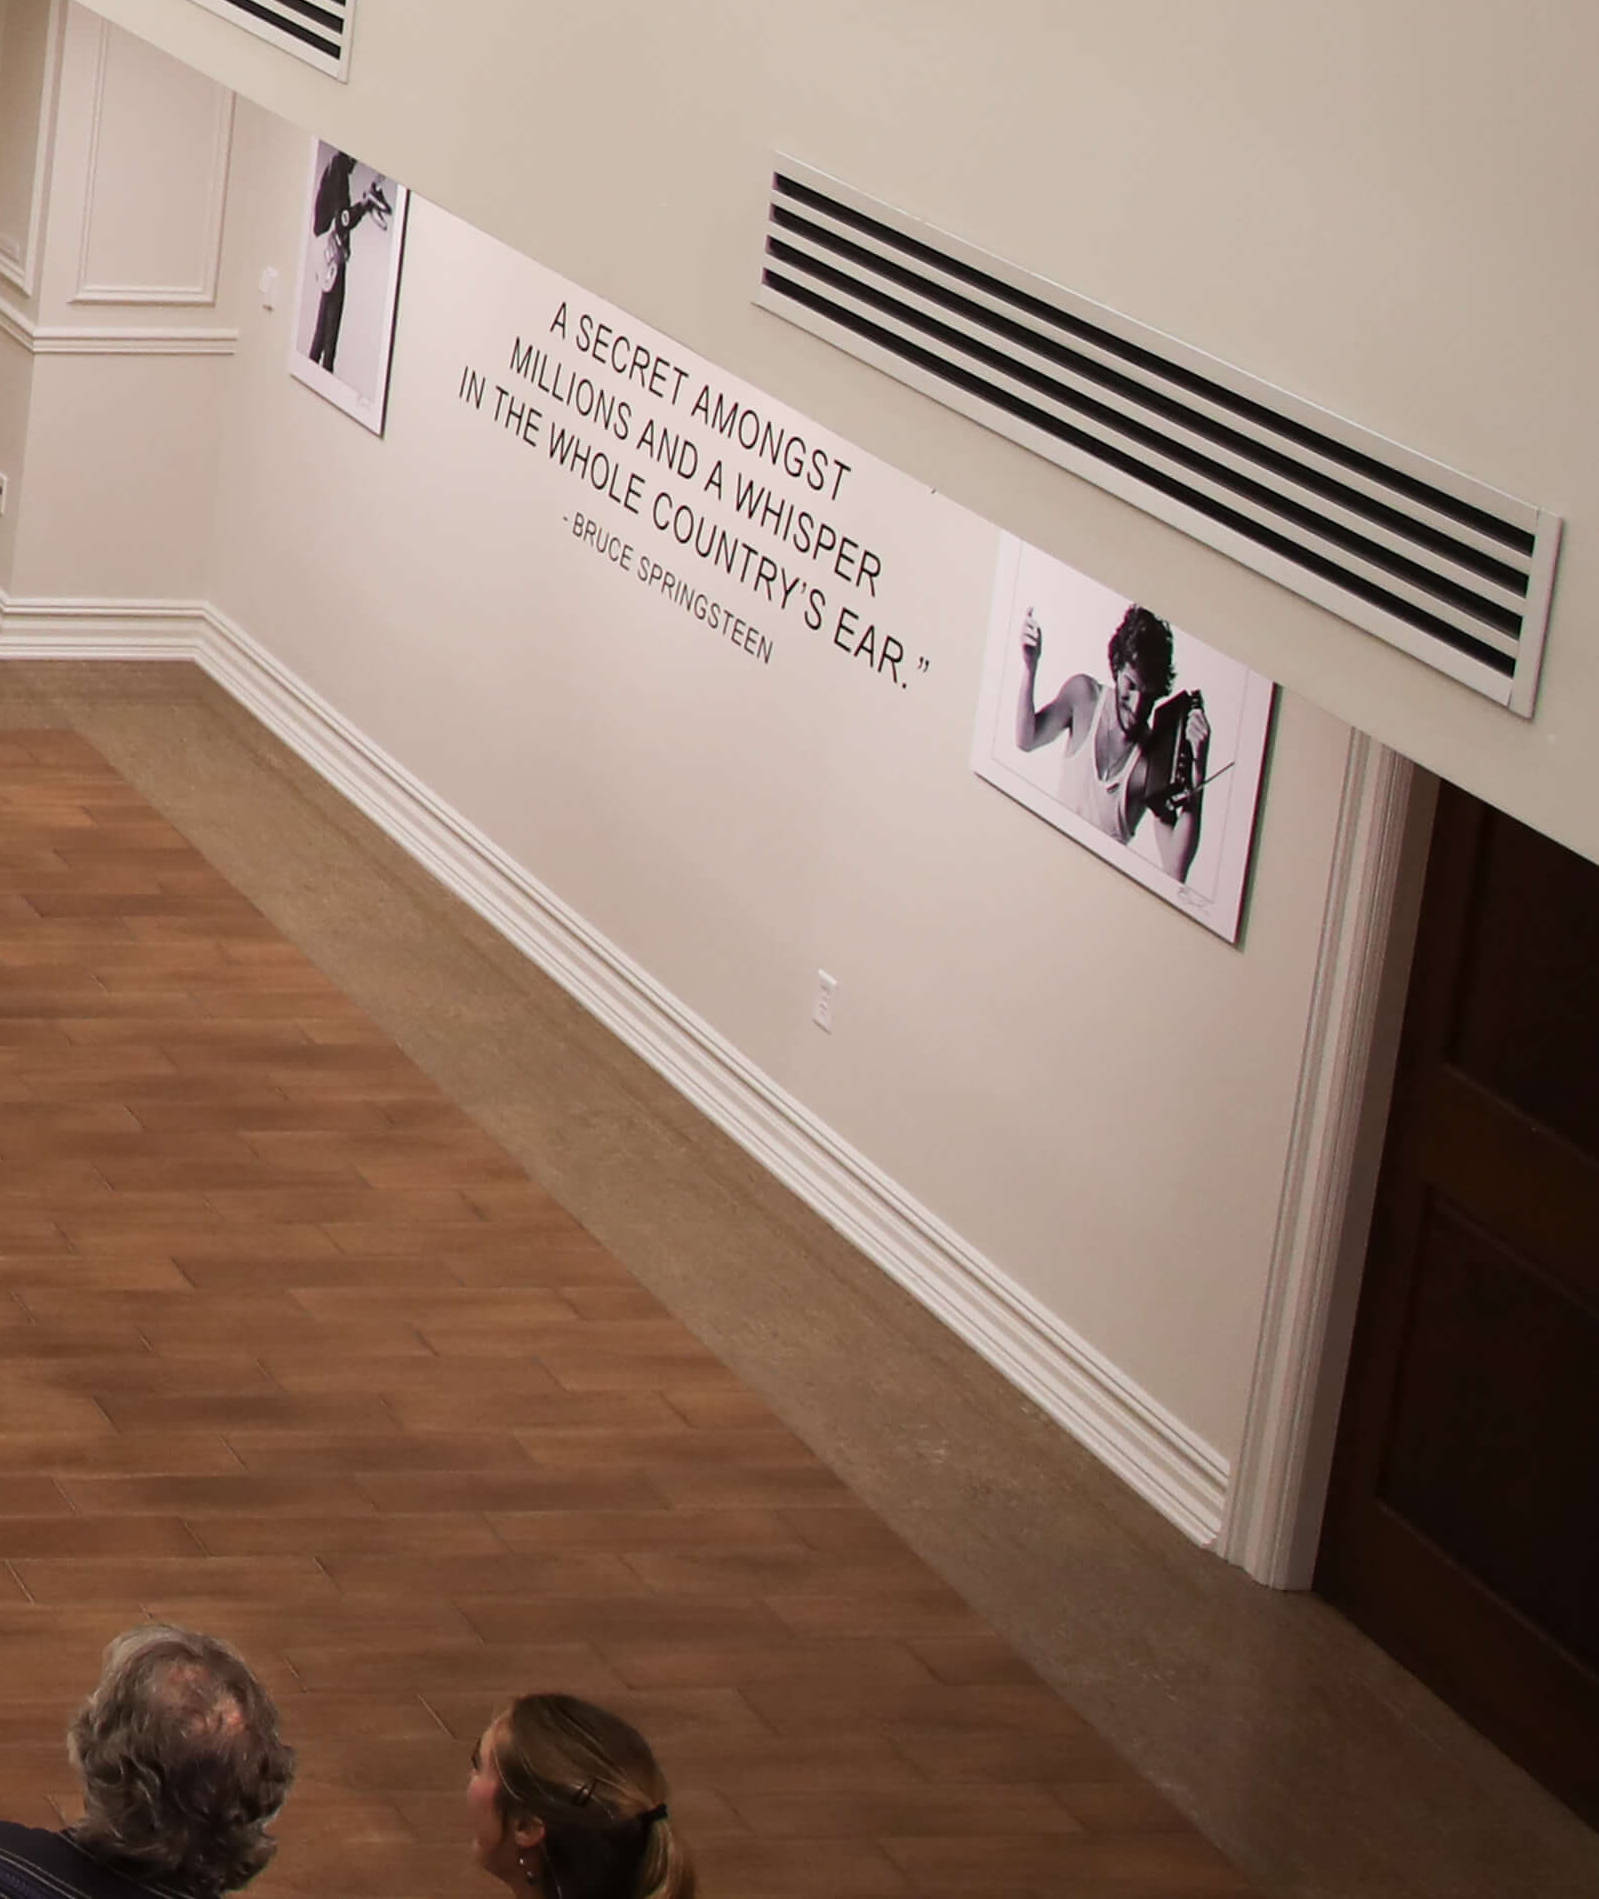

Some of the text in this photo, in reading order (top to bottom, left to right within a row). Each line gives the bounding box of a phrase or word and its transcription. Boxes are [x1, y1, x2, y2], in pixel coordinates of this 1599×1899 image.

[458, 365, 487, 411] IN
[493, 384, 543, 448] THE
[549, 421, 646, 515] WHOLE
[509, 335, 882, 599] MILLIONS AND A WHISPER
[549, 301, 852, 502] A SECRET AMONGST
[571, 511, 635, 572] BRUCE
[637, 555, 774, 665] SPRINGSTEEN
